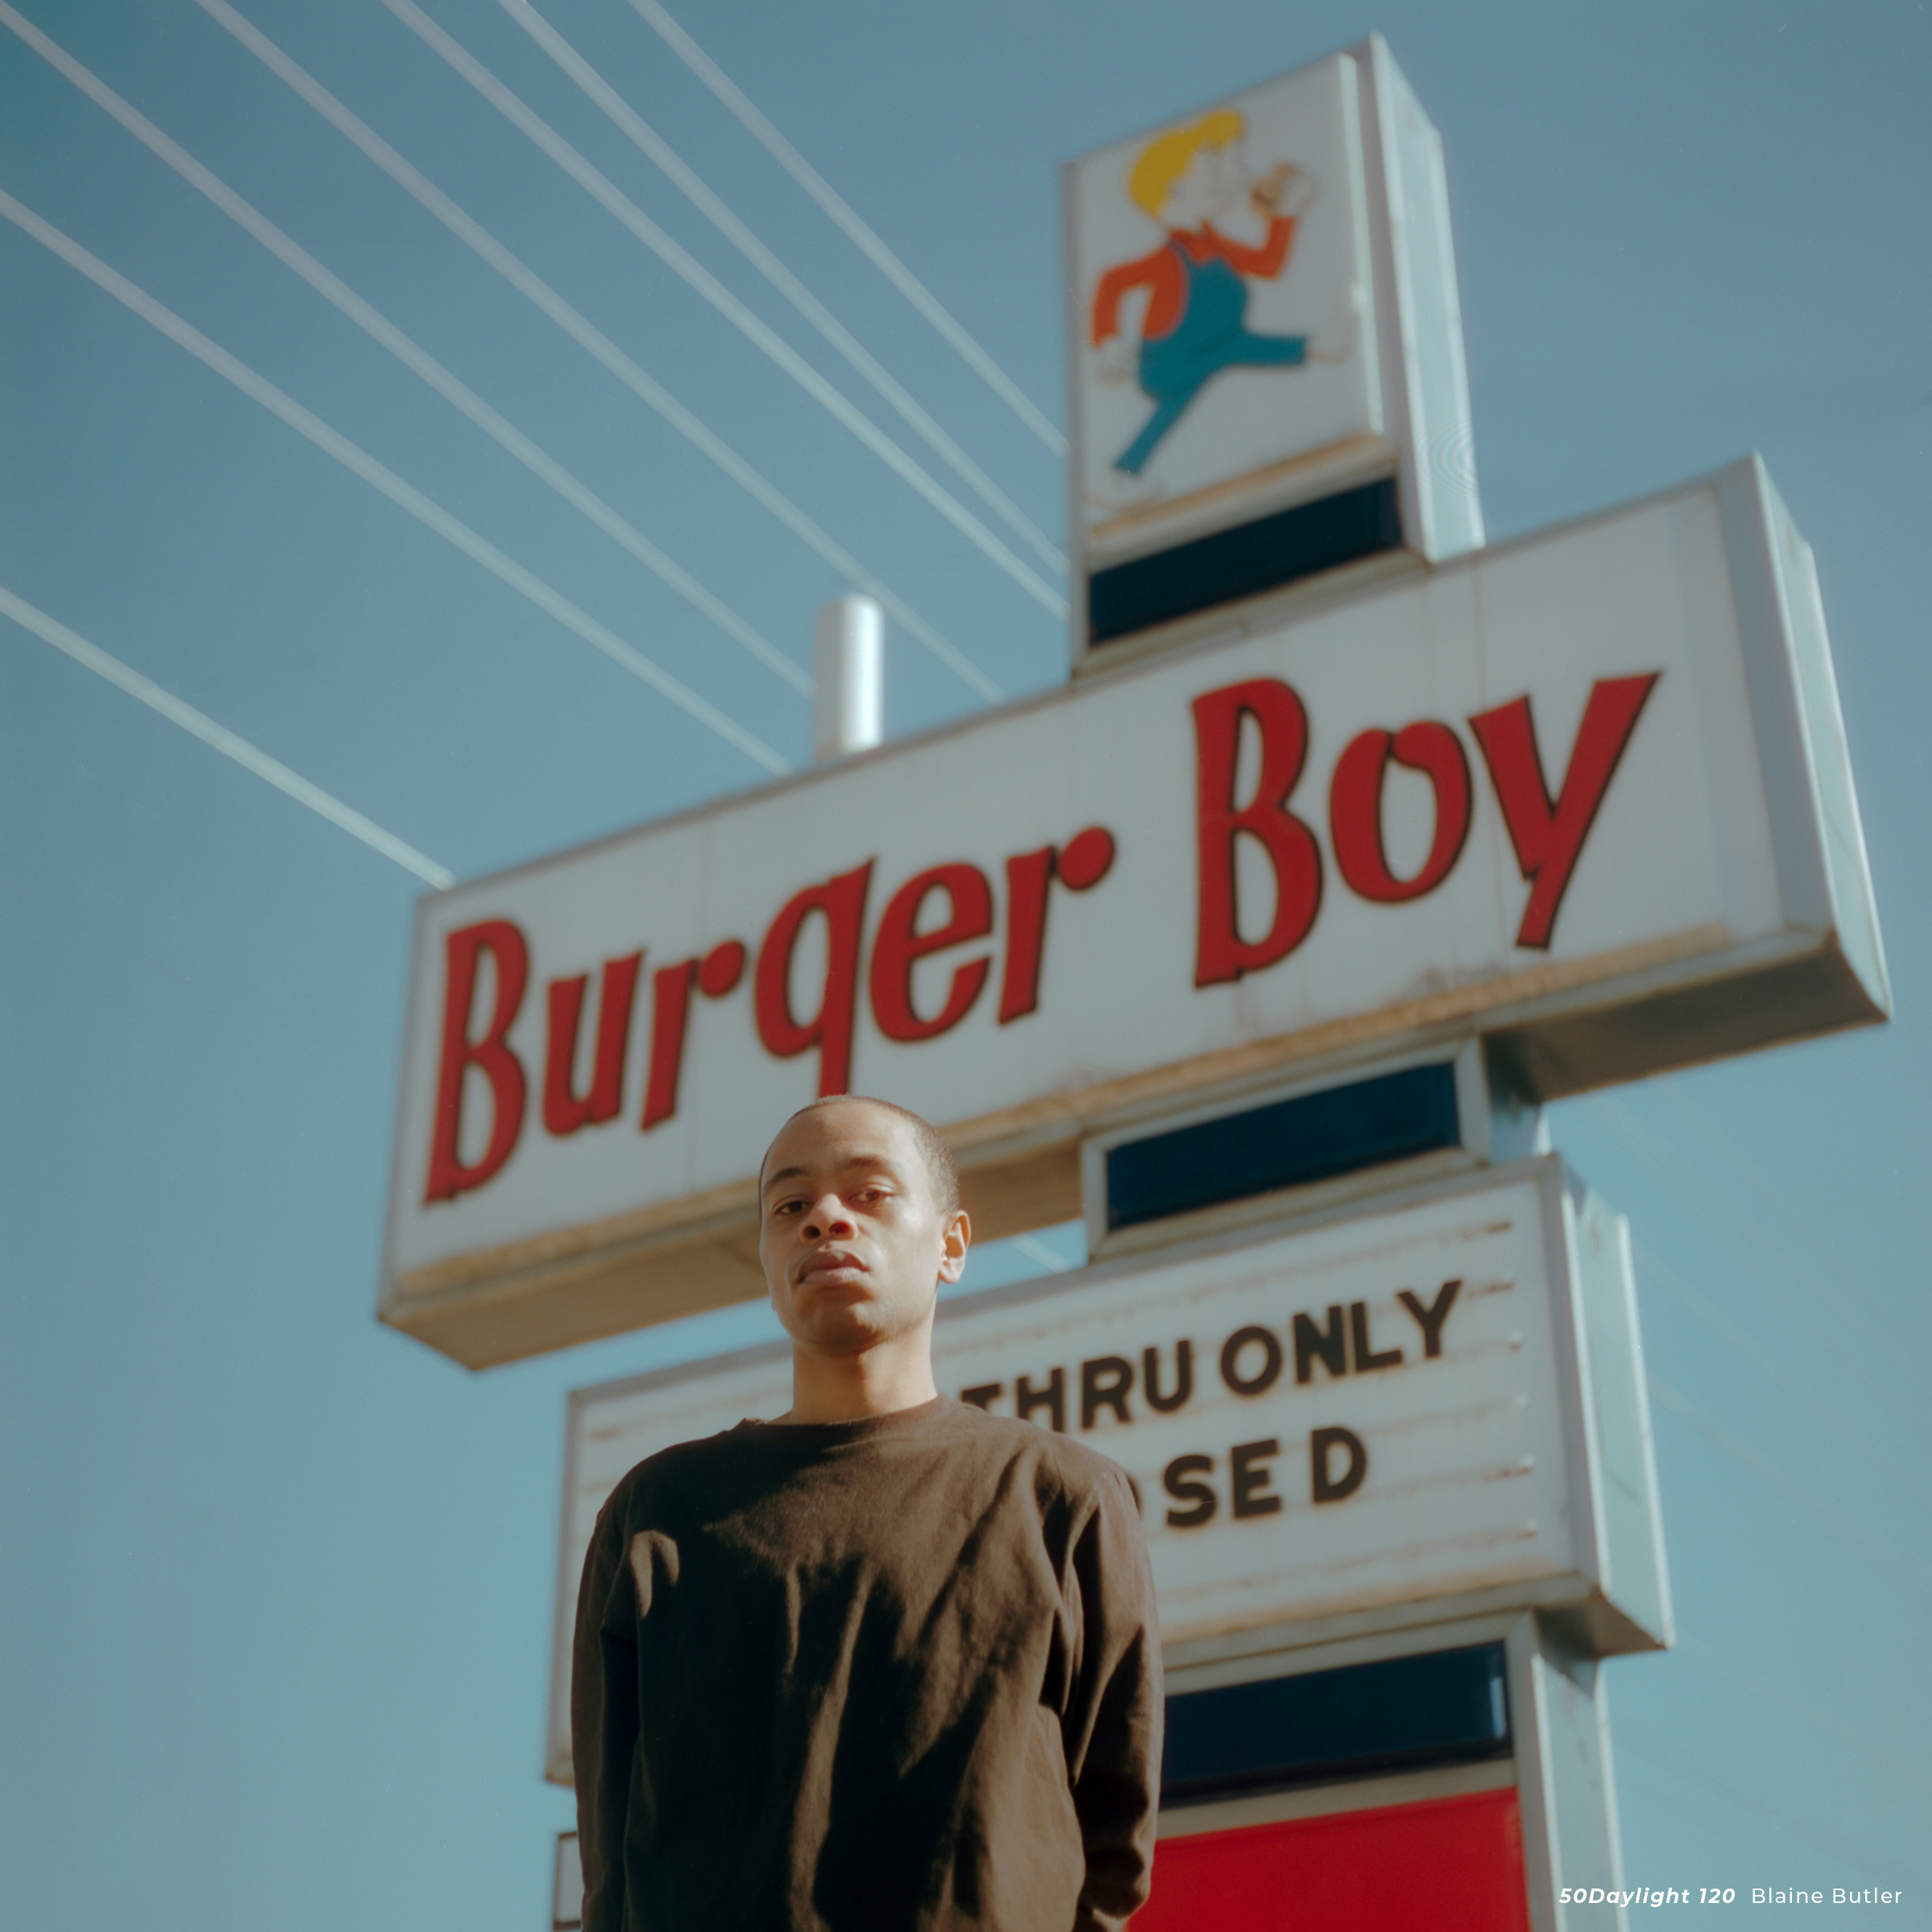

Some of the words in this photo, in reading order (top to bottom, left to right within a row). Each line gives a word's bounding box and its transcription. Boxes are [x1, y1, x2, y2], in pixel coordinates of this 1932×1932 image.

[424, 826, 1115, 1208] Burger
[1191, 671, 1663, 990] Boy
[1220, 1278, 1463, 1396] ONLY
[1127, 1426, 1368, 1528] SED
